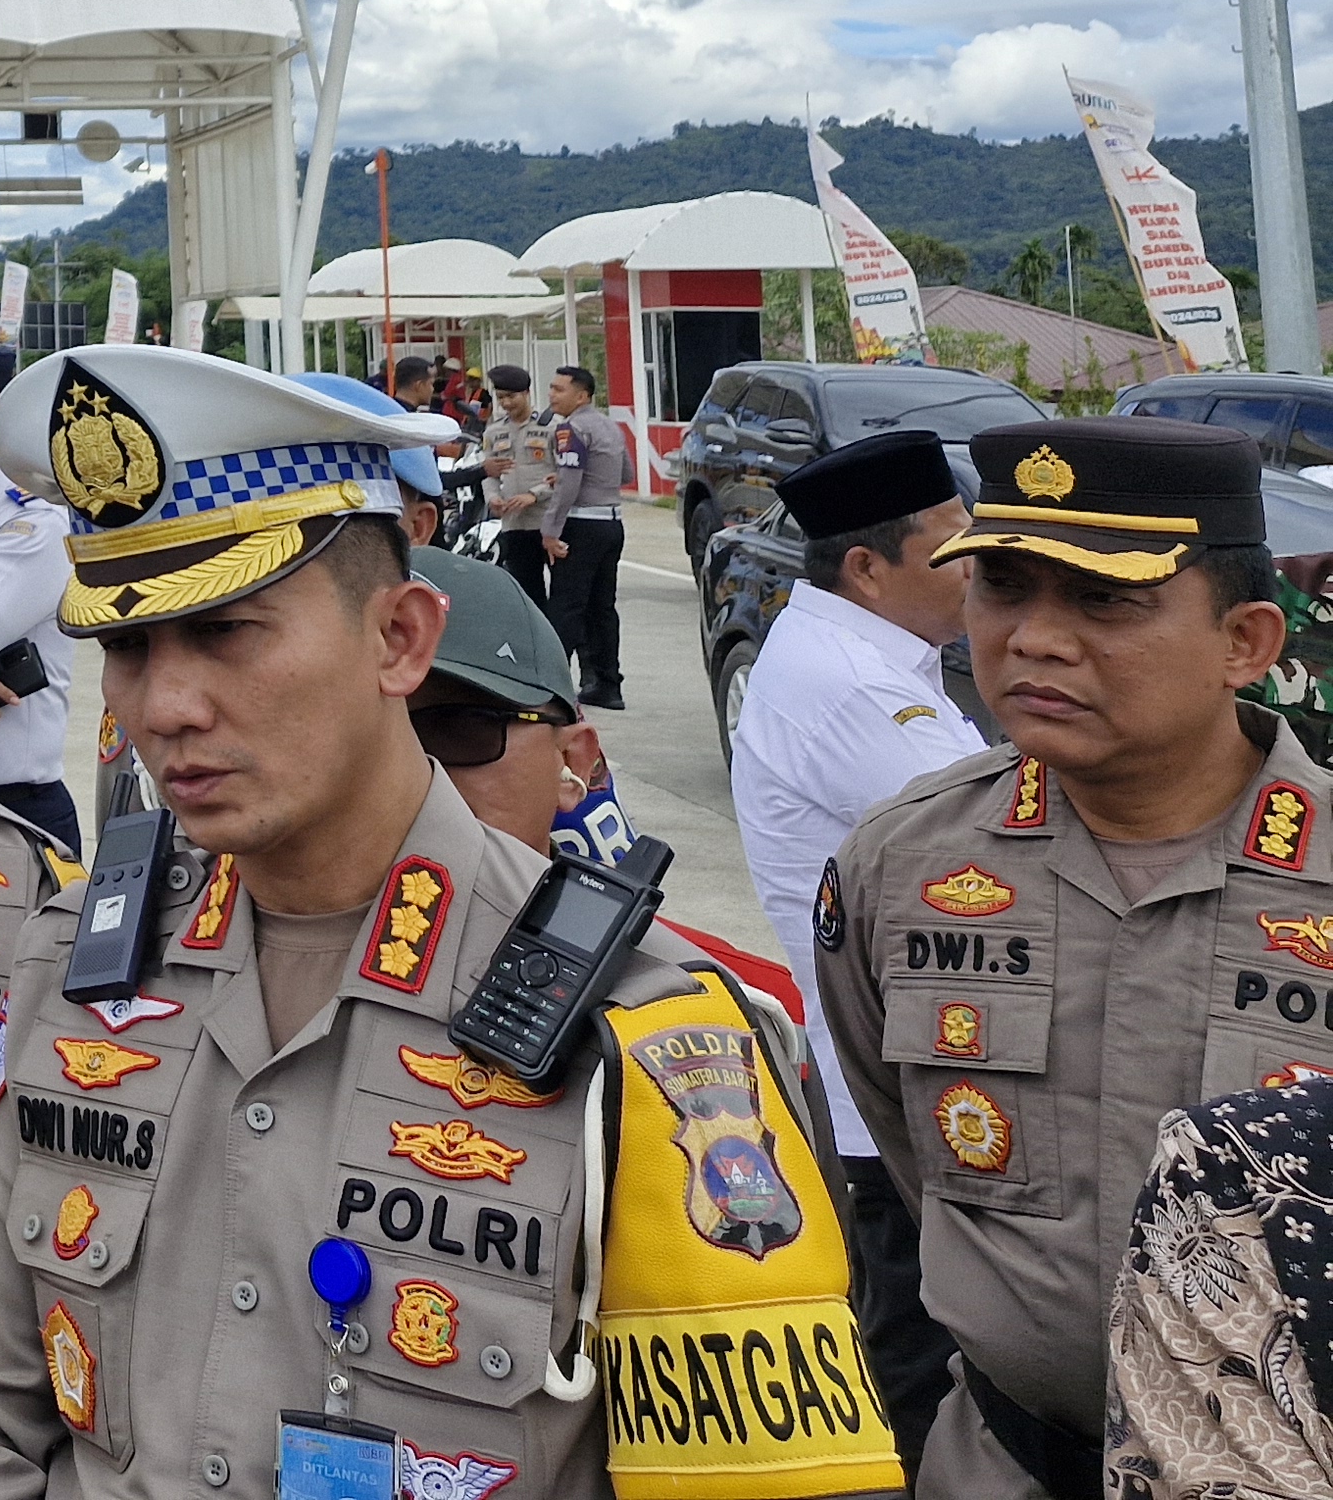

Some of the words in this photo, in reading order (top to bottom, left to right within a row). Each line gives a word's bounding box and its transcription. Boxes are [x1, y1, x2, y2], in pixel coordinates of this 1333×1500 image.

[579, 873, 605, 891] Hytera
[906, 929, 1030, 975] DWI.S
[644, 1031, 745, 1069] POLDA
[664, 1067, 722, 1096] SUMATERA
[722, 1069, 757, 1094] BARAT
[18, 1094, 65, 1152] DWI
[72, 1105, 155, 1170] NUR.S
[337, 1178, 541, 1275] POLRI
[605, 1322, 861, 1446] KASATGAS
[302, 1461, 378, 1486] DITLANTAS
